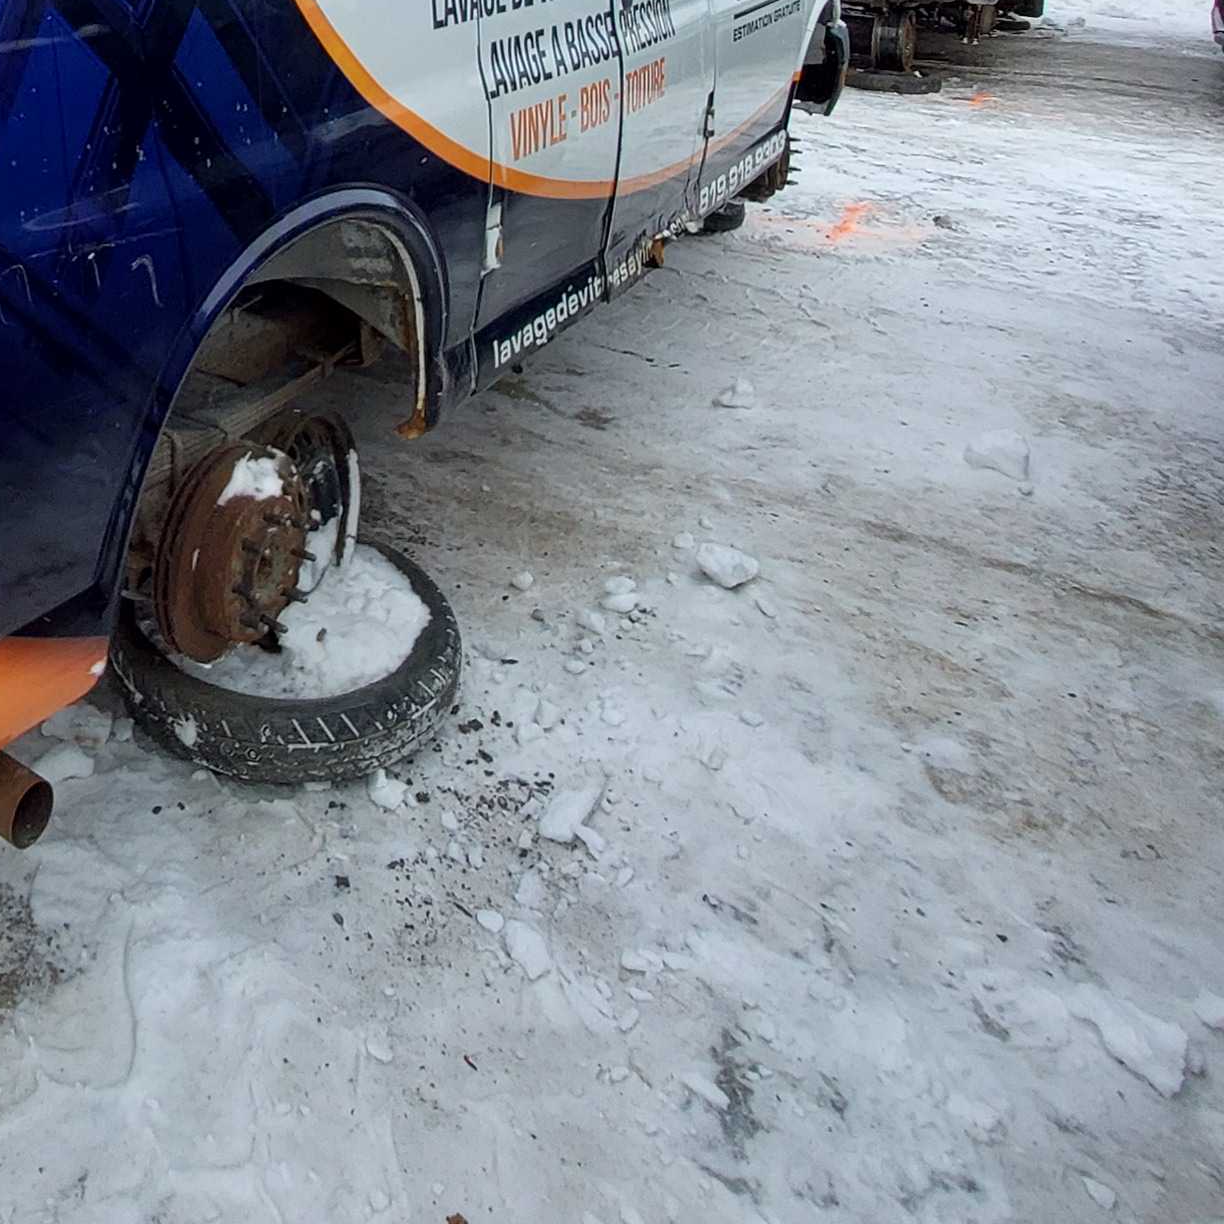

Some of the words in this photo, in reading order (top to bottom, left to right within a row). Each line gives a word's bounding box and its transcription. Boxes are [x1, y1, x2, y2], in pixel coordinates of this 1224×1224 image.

[550, 25, 568, 77] A
[564, 10, 620, 72] BASSE
[510, 93, 569, 162] VINYLE
[580, 77, 612, 134] BOIS
[626, 56, 667, 115] TOITURE
